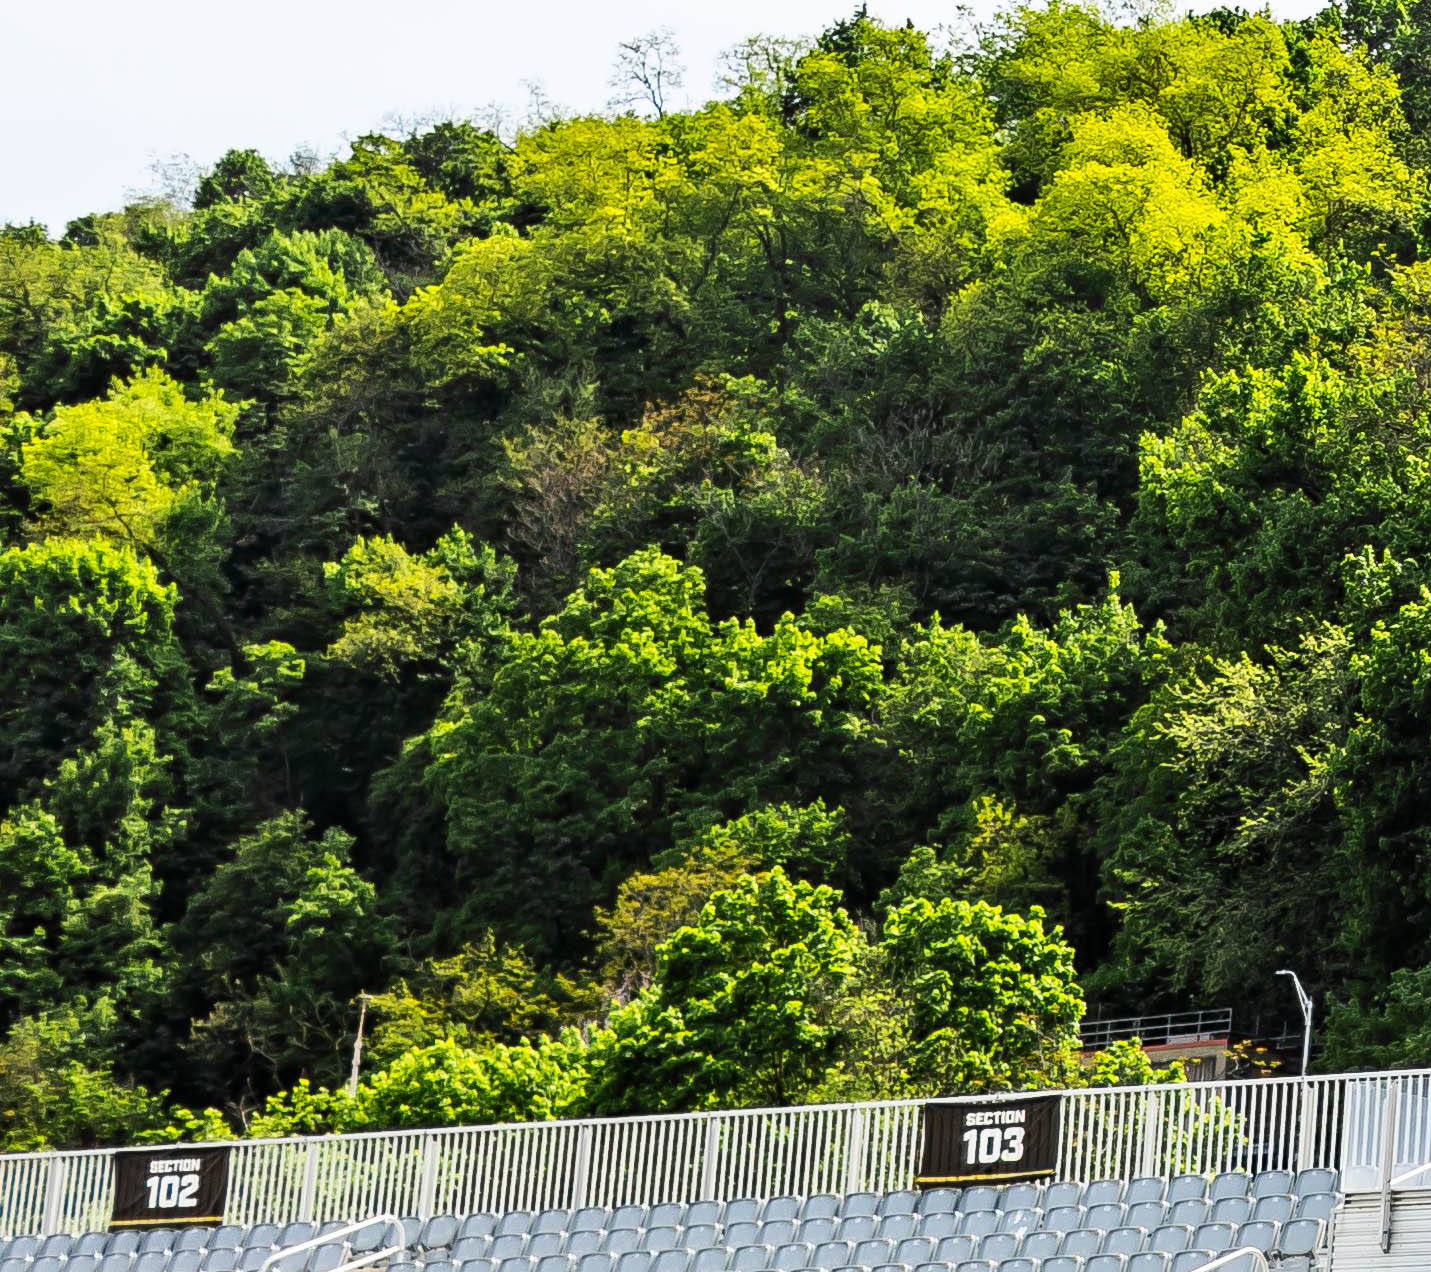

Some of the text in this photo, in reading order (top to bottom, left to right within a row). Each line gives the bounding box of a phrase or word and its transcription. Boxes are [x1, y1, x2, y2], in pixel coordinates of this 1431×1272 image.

[966, 1110, 1025, 1127] SECTION
[963, 1128, 1025, 1164] 103
[150, 1159, 200, 1173] SECTION
[147, 1173, 199, 1208] 102
